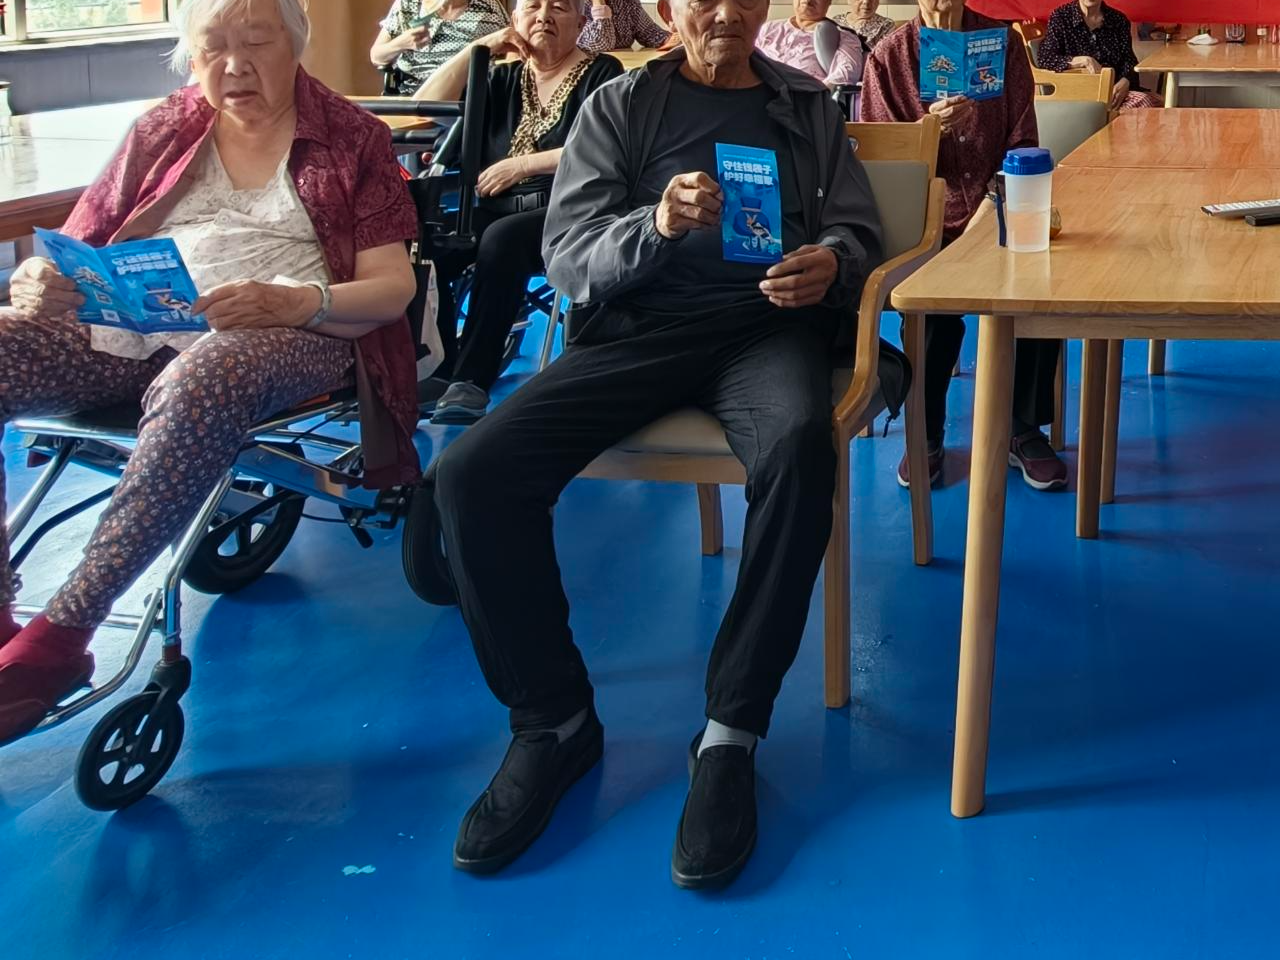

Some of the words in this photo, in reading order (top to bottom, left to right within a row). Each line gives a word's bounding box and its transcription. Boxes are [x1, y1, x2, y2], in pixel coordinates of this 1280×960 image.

[723, 160, 773, 175] 守住钱袋子
